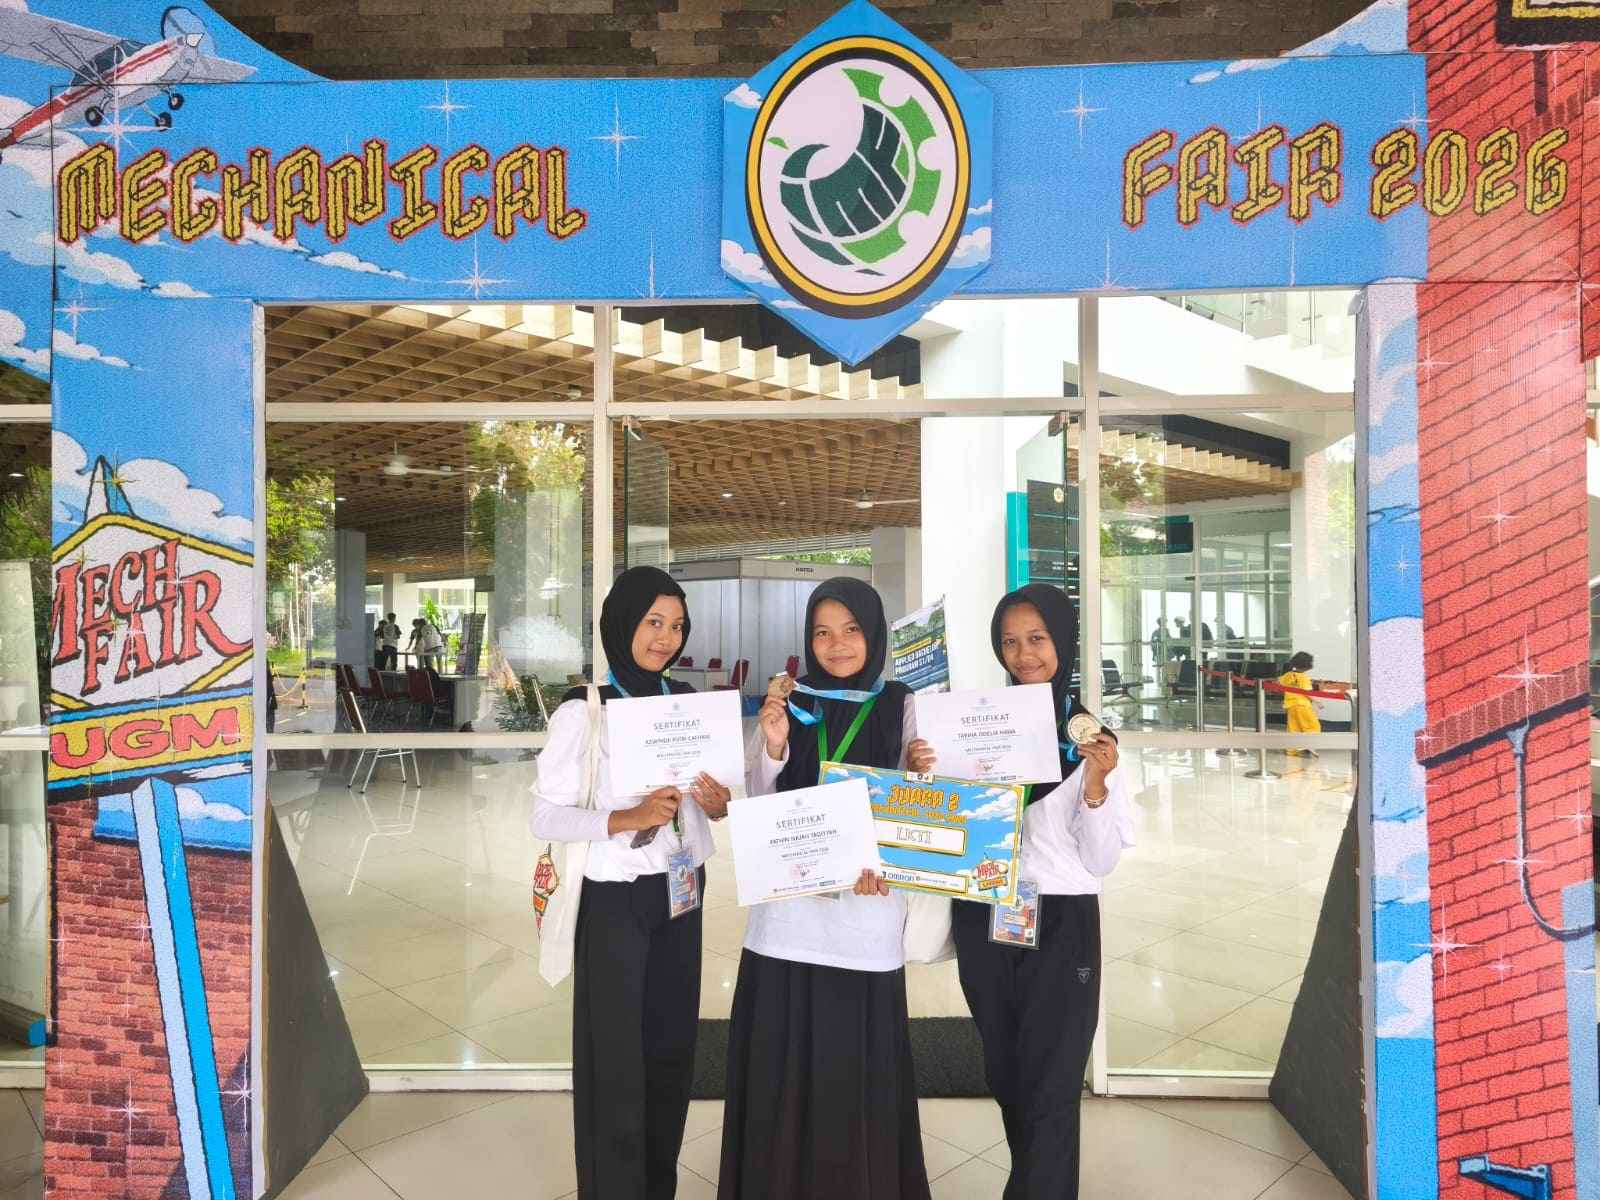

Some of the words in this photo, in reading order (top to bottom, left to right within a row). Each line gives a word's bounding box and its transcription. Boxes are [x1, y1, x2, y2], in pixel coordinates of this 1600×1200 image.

[57, 138, 587, 243] MECHANICAL
[1122, 123, 1341, 227] FAIR
[1370, 127, 1569, 217] 2026
[80, 568, 253, 697] FAIR
[51, 706, 241, 769] UGM
[653, 719, 701, 731] SERTIFIKAT
[960, 713, 1010, 725] SERTIFIKAT
[776, 813, 826, 830] SERTIFIKAT
